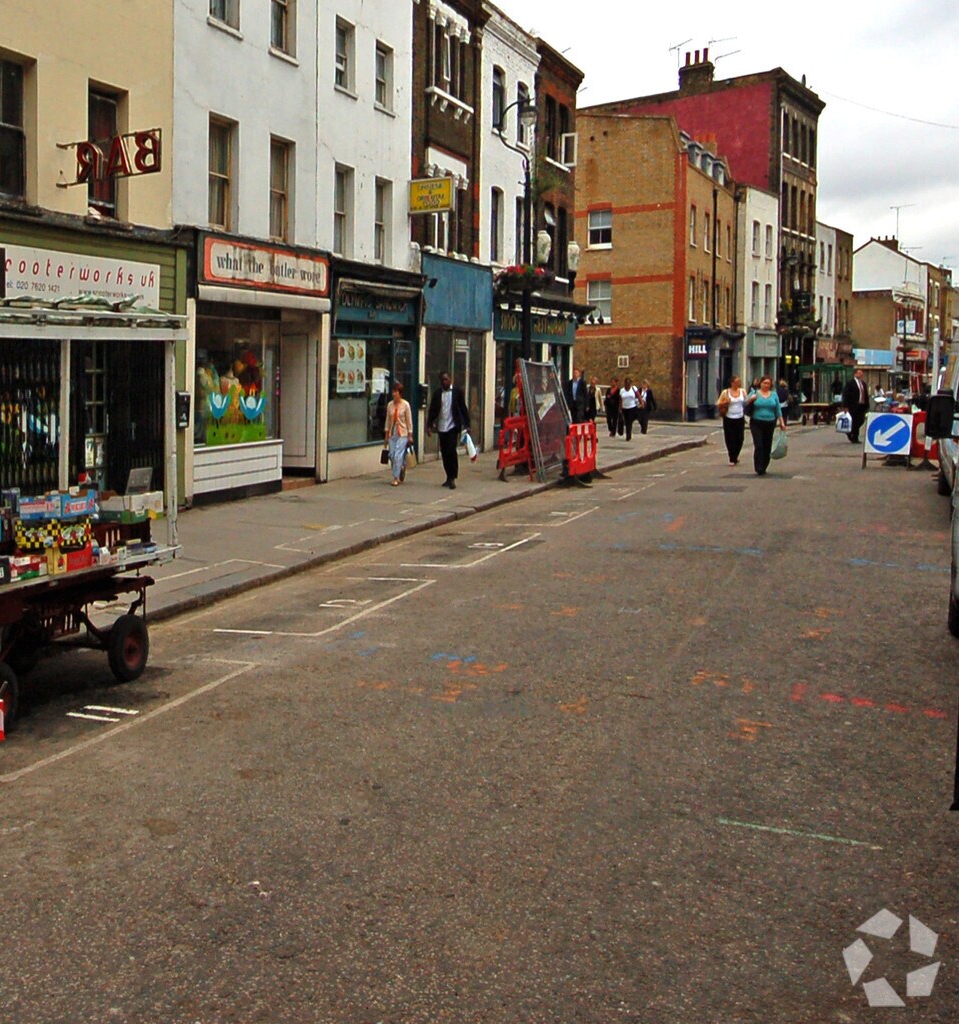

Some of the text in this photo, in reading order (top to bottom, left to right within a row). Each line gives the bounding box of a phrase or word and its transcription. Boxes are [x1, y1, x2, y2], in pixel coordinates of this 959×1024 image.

[4, 258, 134, 286] cooterworks
[216, 252, 243, 272] what
[247, 256, 264, 274] the
[688, 344, 708, 355] HILL
